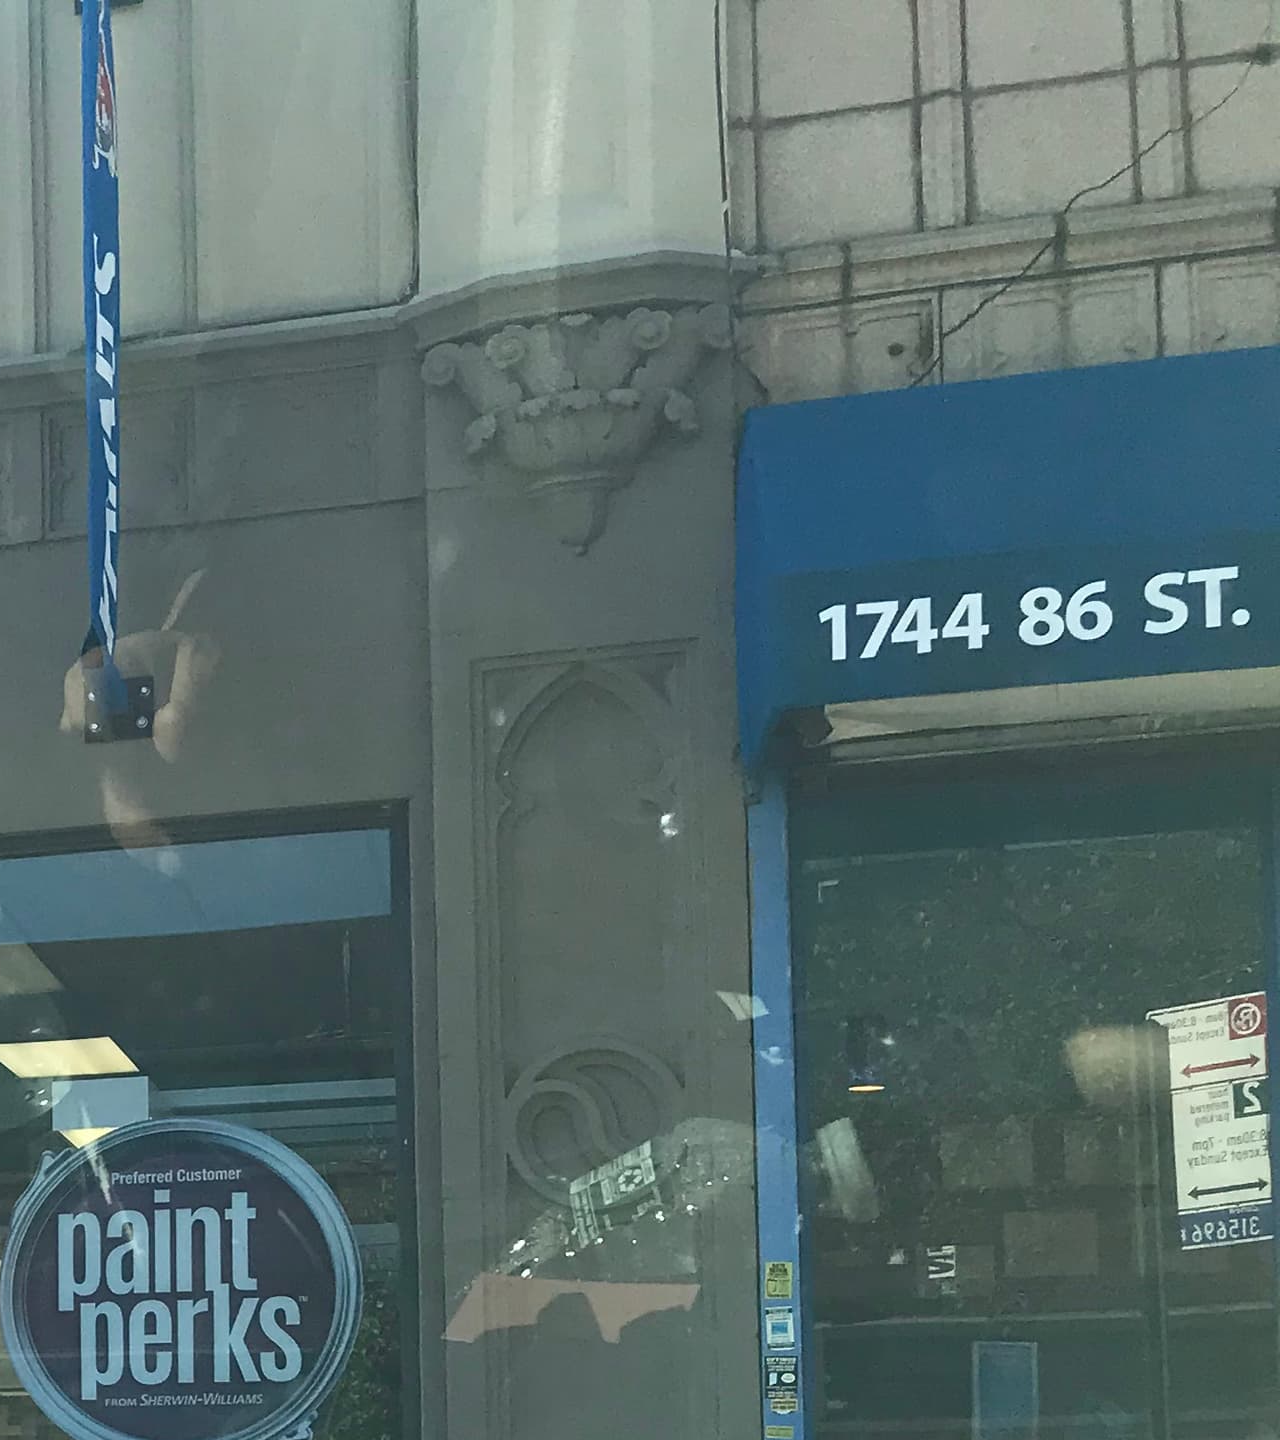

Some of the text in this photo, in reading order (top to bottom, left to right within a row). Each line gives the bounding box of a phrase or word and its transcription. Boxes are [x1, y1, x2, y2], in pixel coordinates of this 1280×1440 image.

[818, 566, 1250, 661] 1744 86 ST.
[111, 1168, 242, 1185] Preferred Customer
[57, 1189, 258, 1310] paint
[80, 1283, 302, 1400] perks
[104, 1392, 263, 1408] FROM SHERWIN-WILLIAMS
